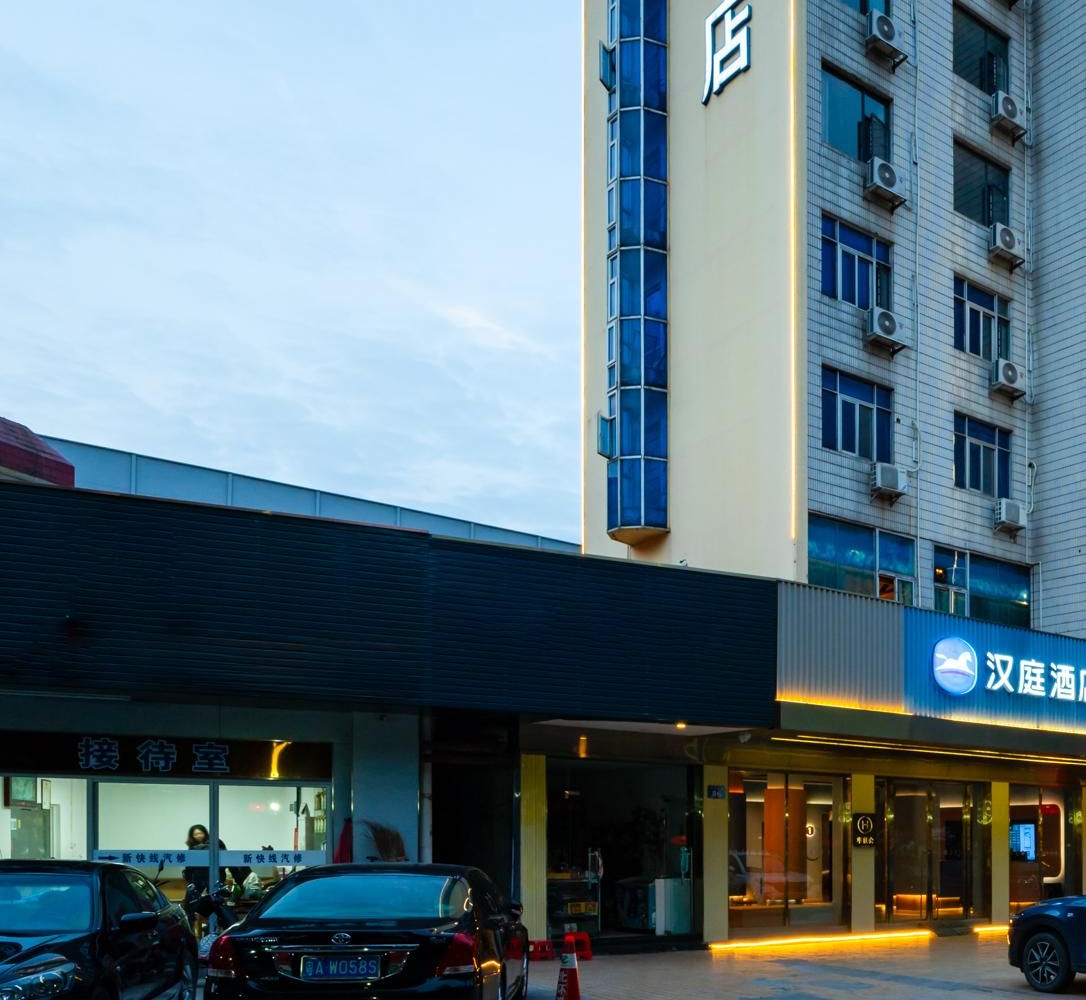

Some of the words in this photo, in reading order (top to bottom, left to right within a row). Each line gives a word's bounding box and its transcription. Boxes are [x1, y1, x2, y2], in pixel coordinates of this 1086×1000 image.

[78, 737, 230, 773] 接待室
[121, 852, 187, 865] 新快线汽修
[243, 852, 303, 864] 新快线汽修
